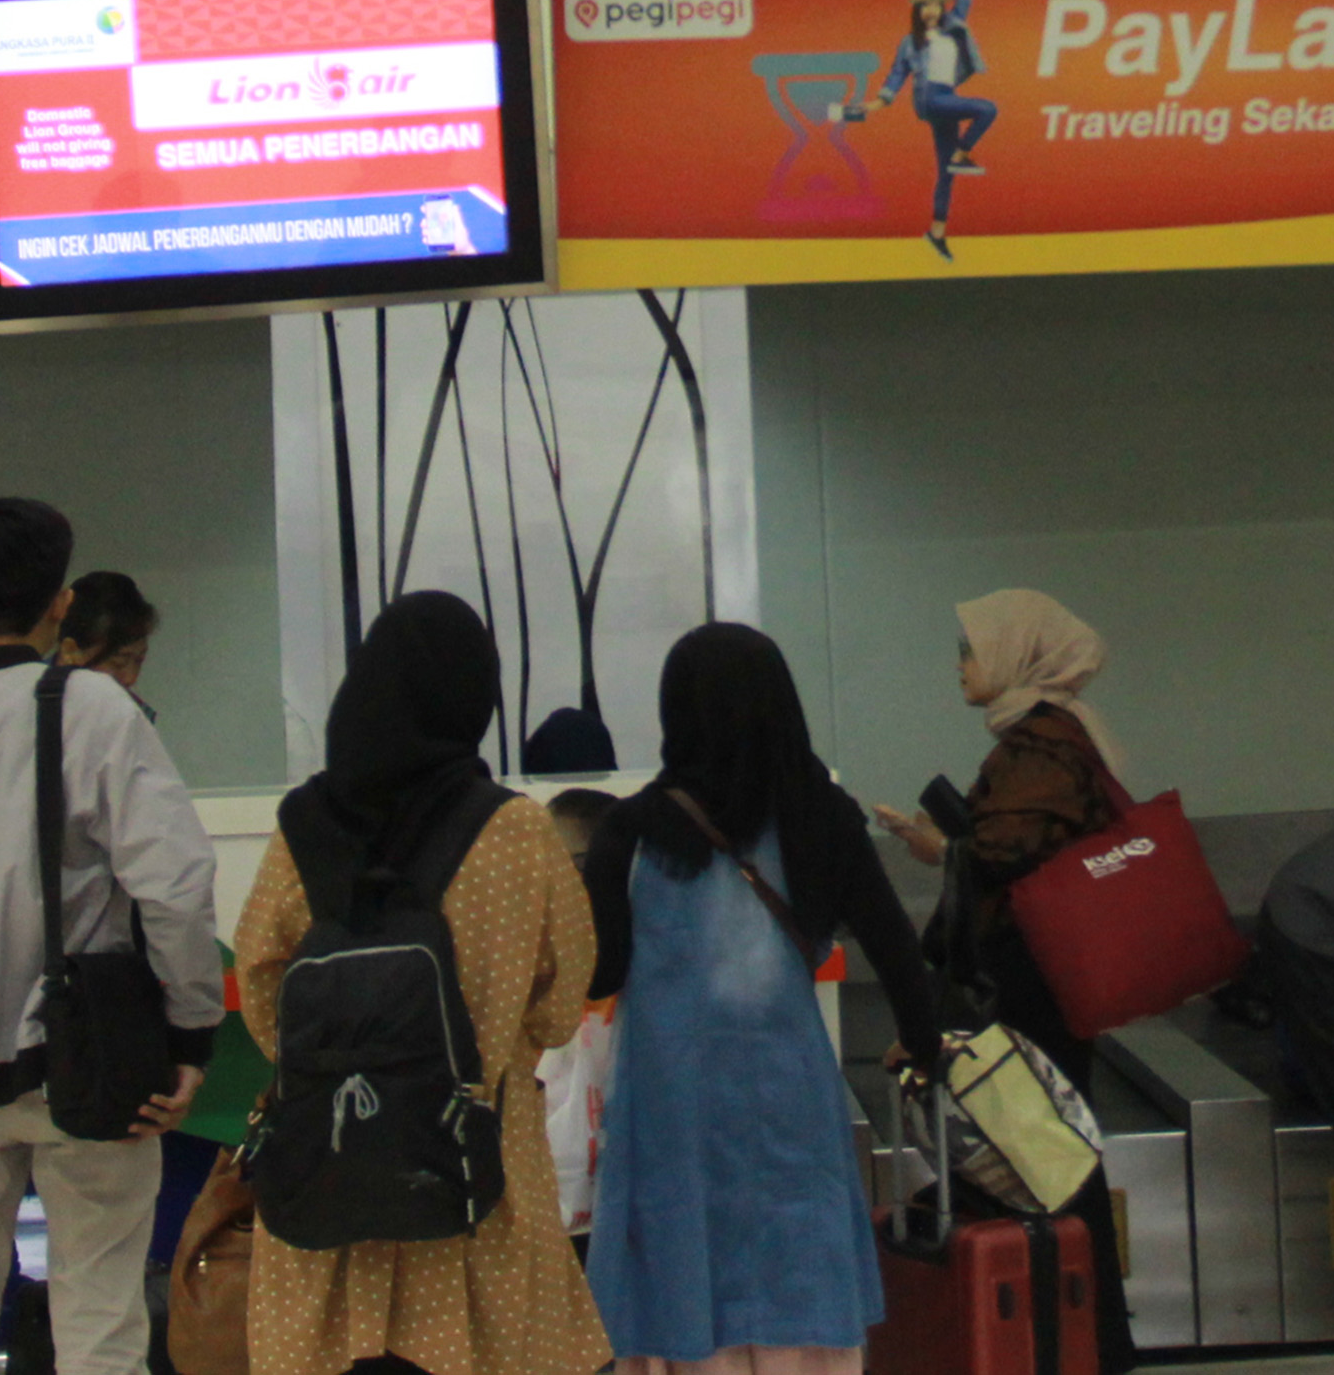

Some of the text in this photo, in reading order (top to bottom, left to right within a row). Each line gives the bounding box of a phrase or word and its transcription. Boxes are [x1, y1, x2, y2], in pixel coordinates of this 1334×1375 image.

[207, 65, 415, 107] Lion air
[23, 123, 101, 139] Lion Group
[26, 106, 93, 123] Domestic
[1041, 98, 1230, 145] Traveling
[157, 124, 481, 170] SEMUA PENERBANGAN
[18, 236, 55, 260] INGIN
[59, 235, 89, 258] CEK
[92, 231, 151, 256] JADWAL
[153, 223, 282, 252] PENERBANGANMU
[285, 219, 343, 243] DENGAN
[346, 215, 398, 239] MUDAH
